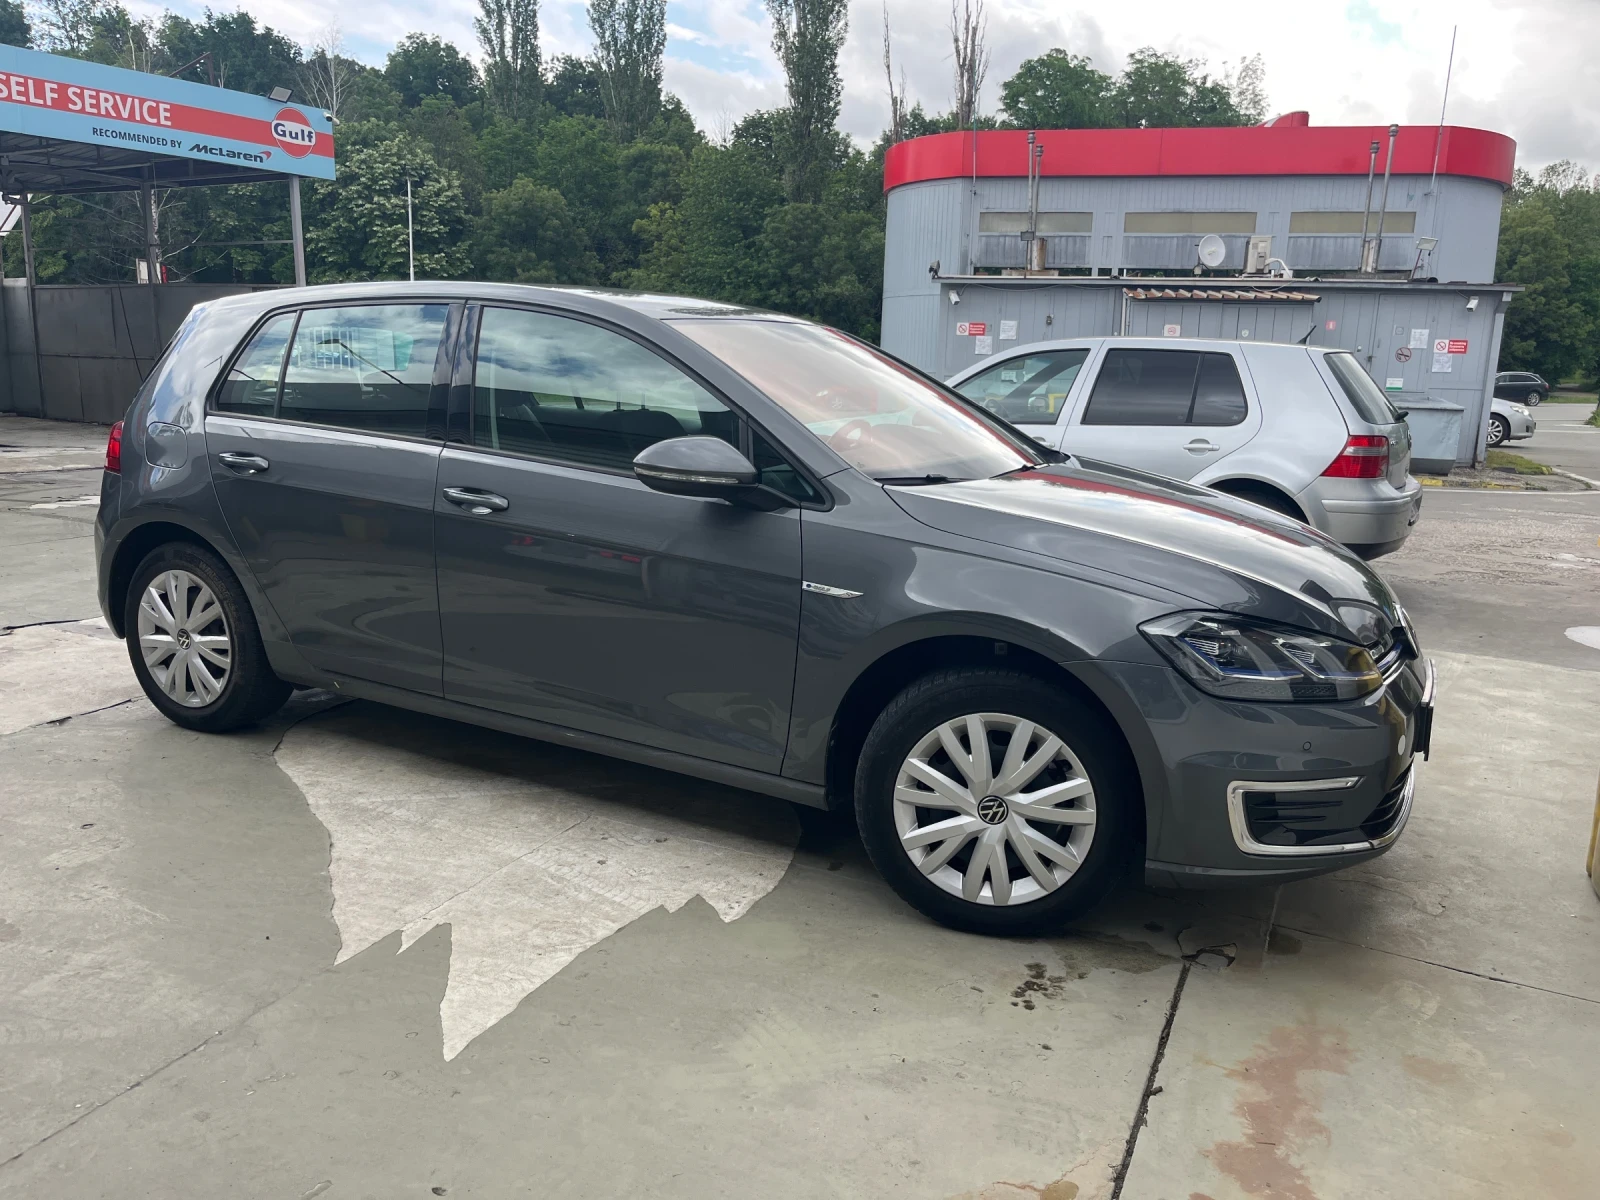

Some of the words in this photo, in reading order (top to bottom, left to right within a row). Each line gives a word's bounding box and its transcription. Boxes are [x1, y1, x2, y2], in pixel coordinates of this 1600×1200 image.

[67, 86, 172, 126] SERVICE
[92, 127, 168, 147] RECOMMENDED
[170, 139, 182, 149] BY
[273, 122, 314, 143] Gulf
[188, 143, 264, 163] McLaren
